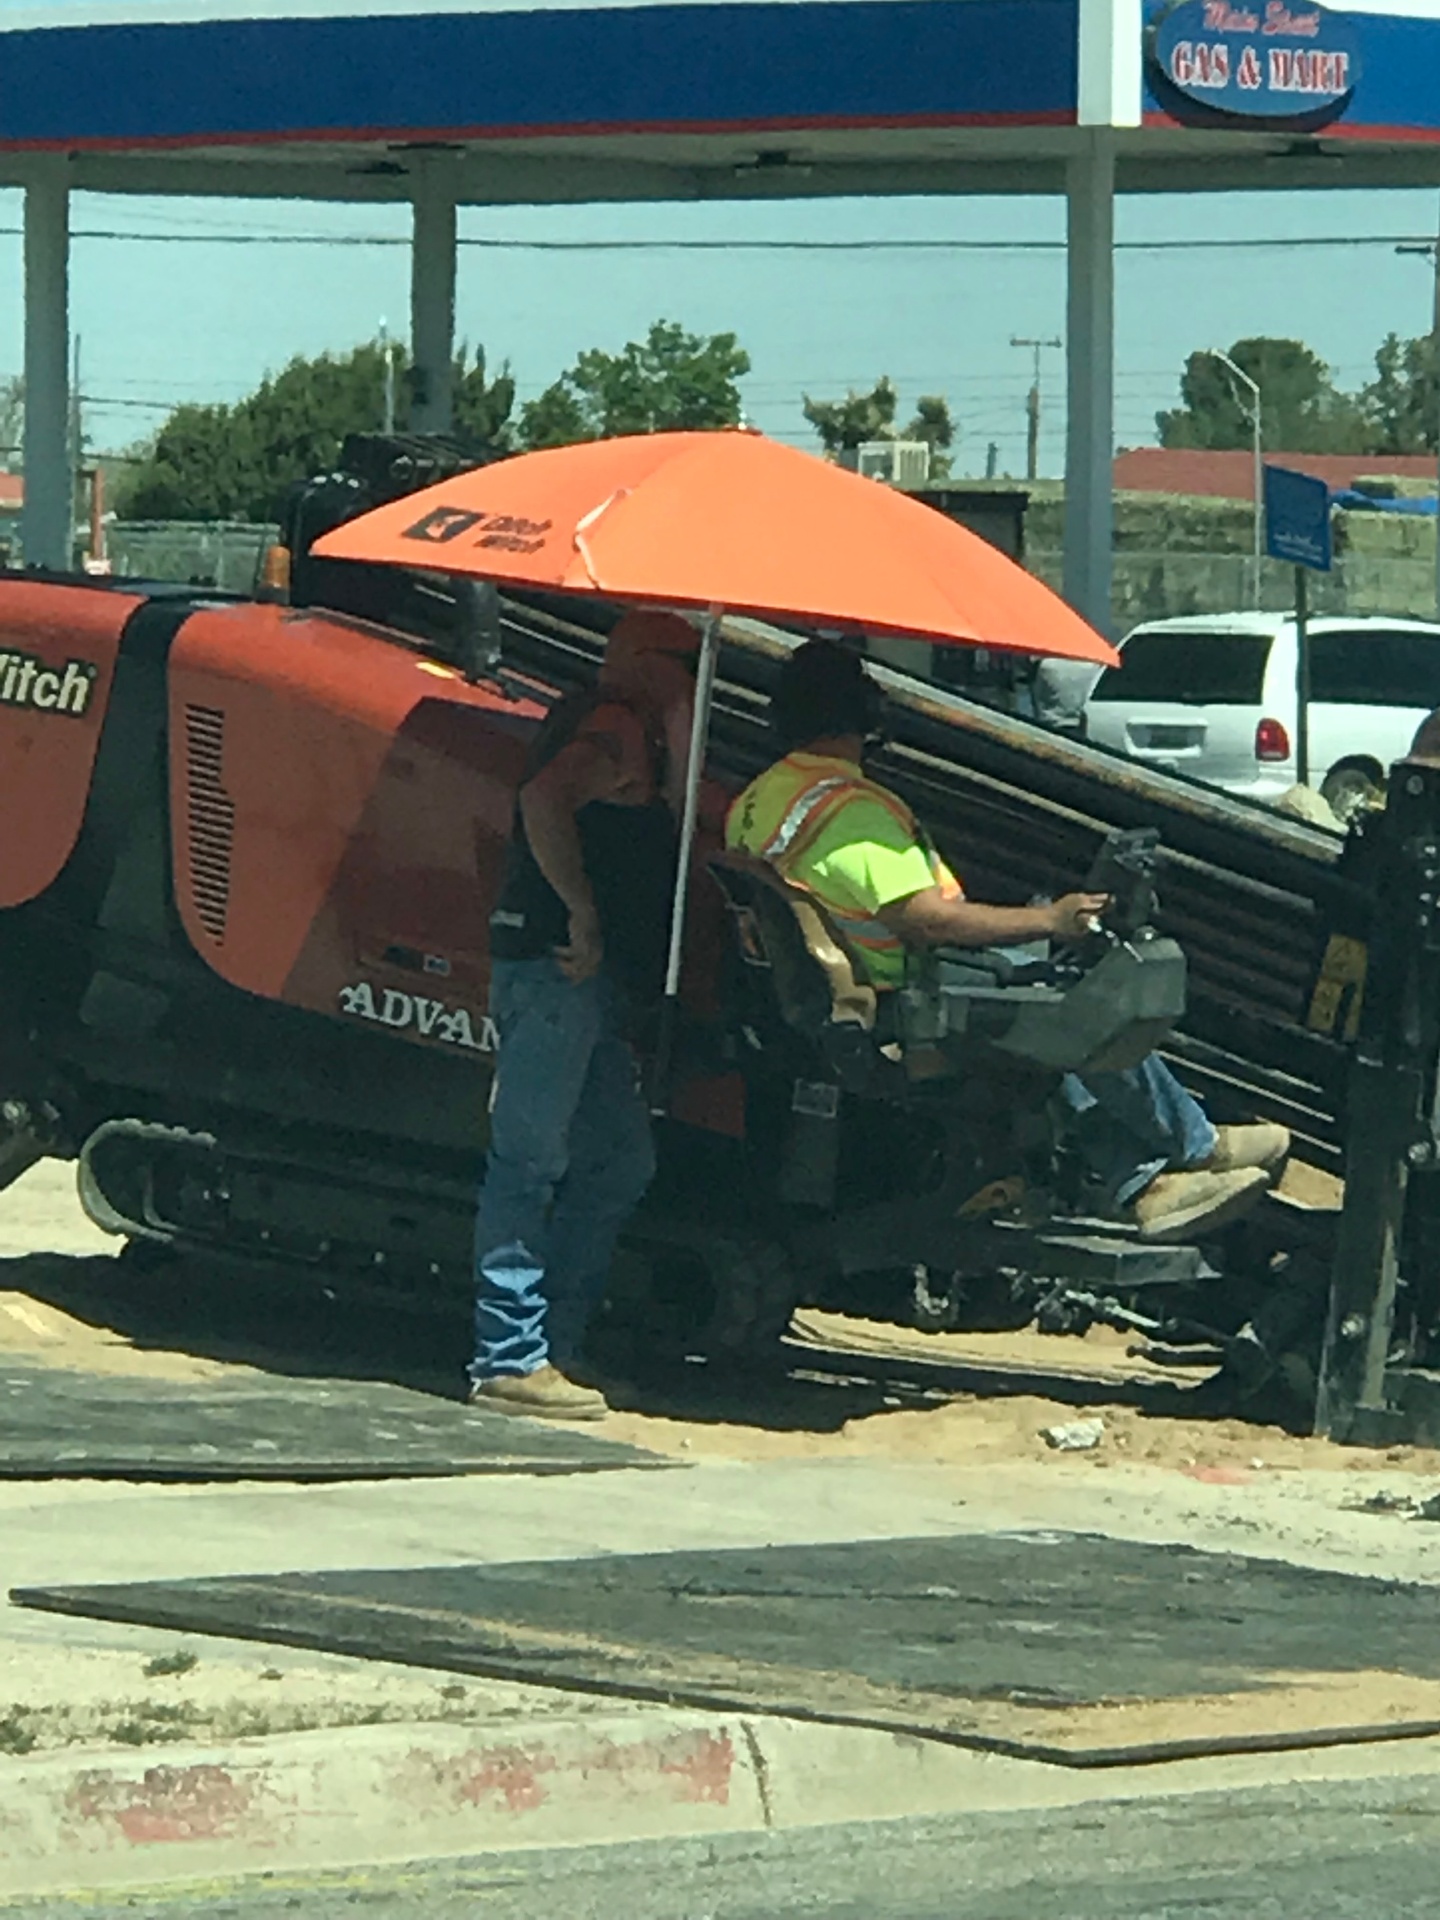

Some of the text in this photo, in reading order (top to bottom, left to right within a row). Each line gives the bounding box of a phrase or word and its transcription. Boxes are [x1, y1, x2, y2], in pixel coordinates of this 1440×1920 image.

[1204, 0, 1259, 33] Main
[1171, 40, 1349, 95] GAS & MART
